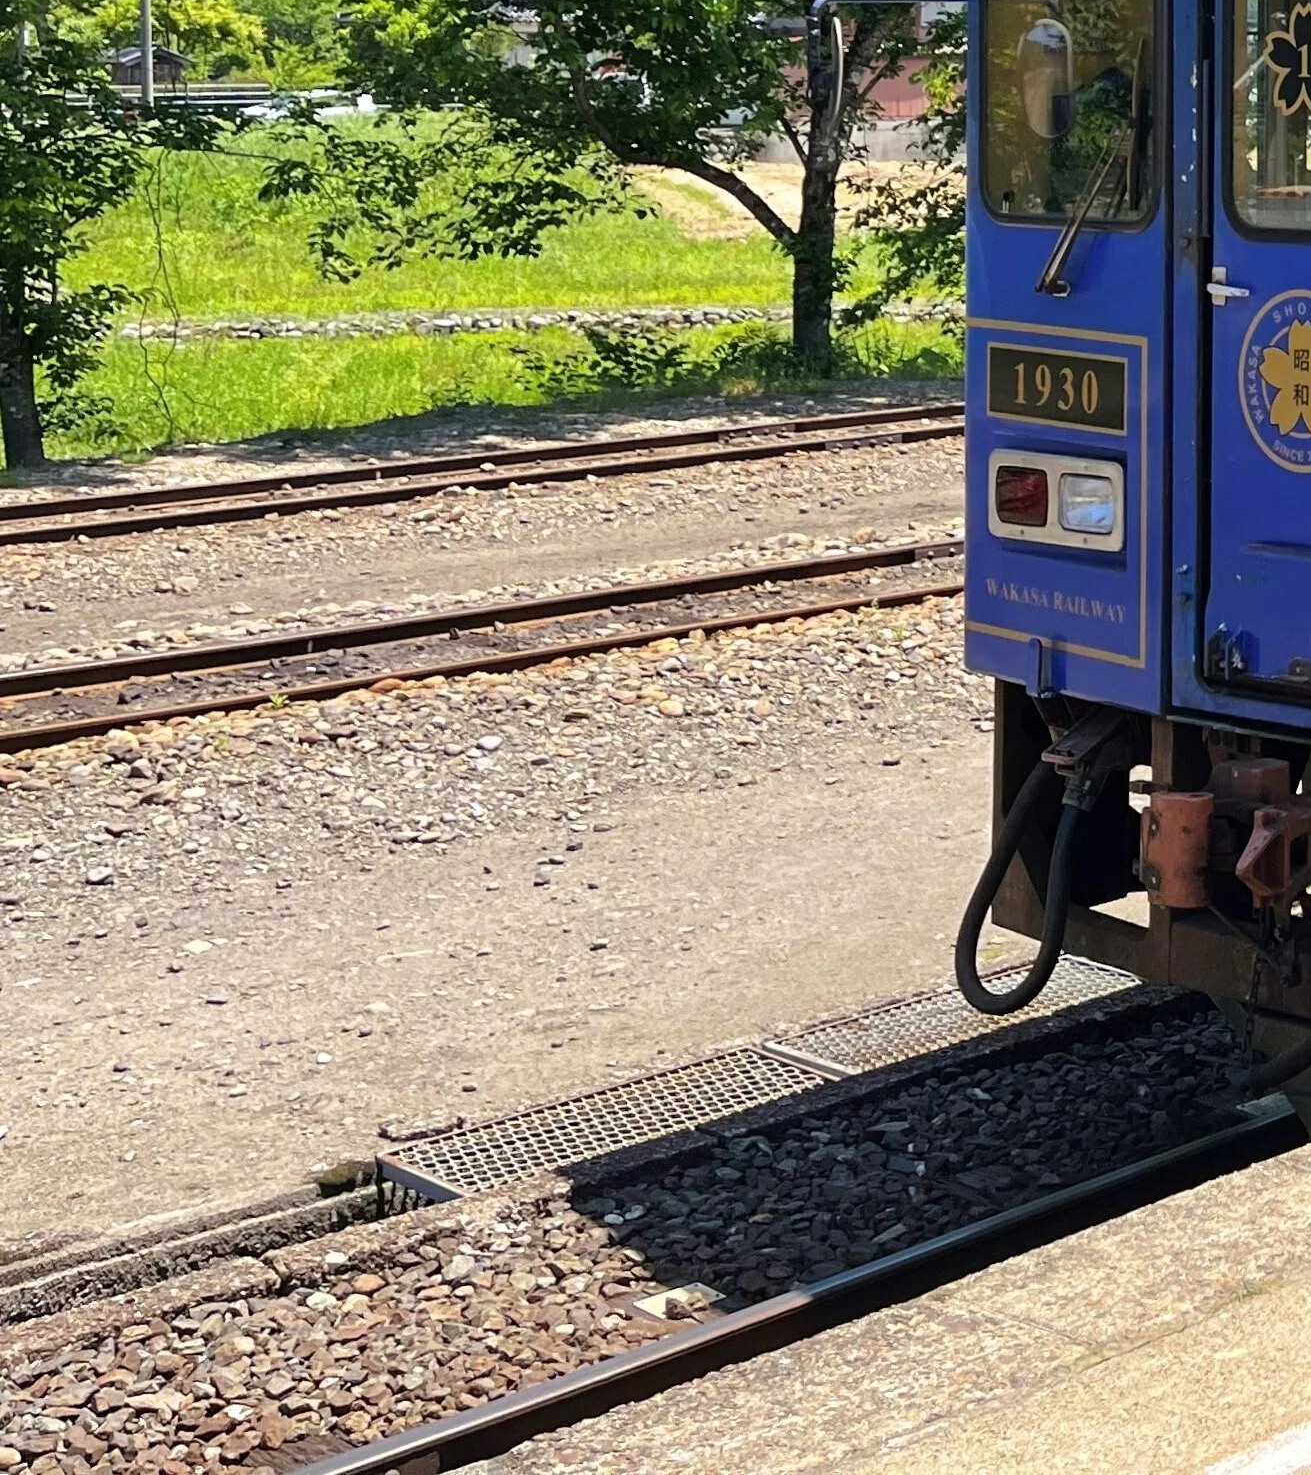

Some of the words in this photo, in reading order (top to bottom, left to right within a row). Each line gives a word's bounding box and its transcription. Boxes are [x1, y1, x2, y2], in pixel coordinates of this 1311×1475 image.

[1297, 43, 1311, 78] 1
[1013, 362, 1099, 415] 1930
[1247, 345, 1264, 424] WAKASA
[1292, 348, 1310, 407] 昭和
[1272, 440, 1304, 462] SINCE
[985, 577, 1049, 610] WAKASA
[1053, 591, 1127, 625] RAILWAY
